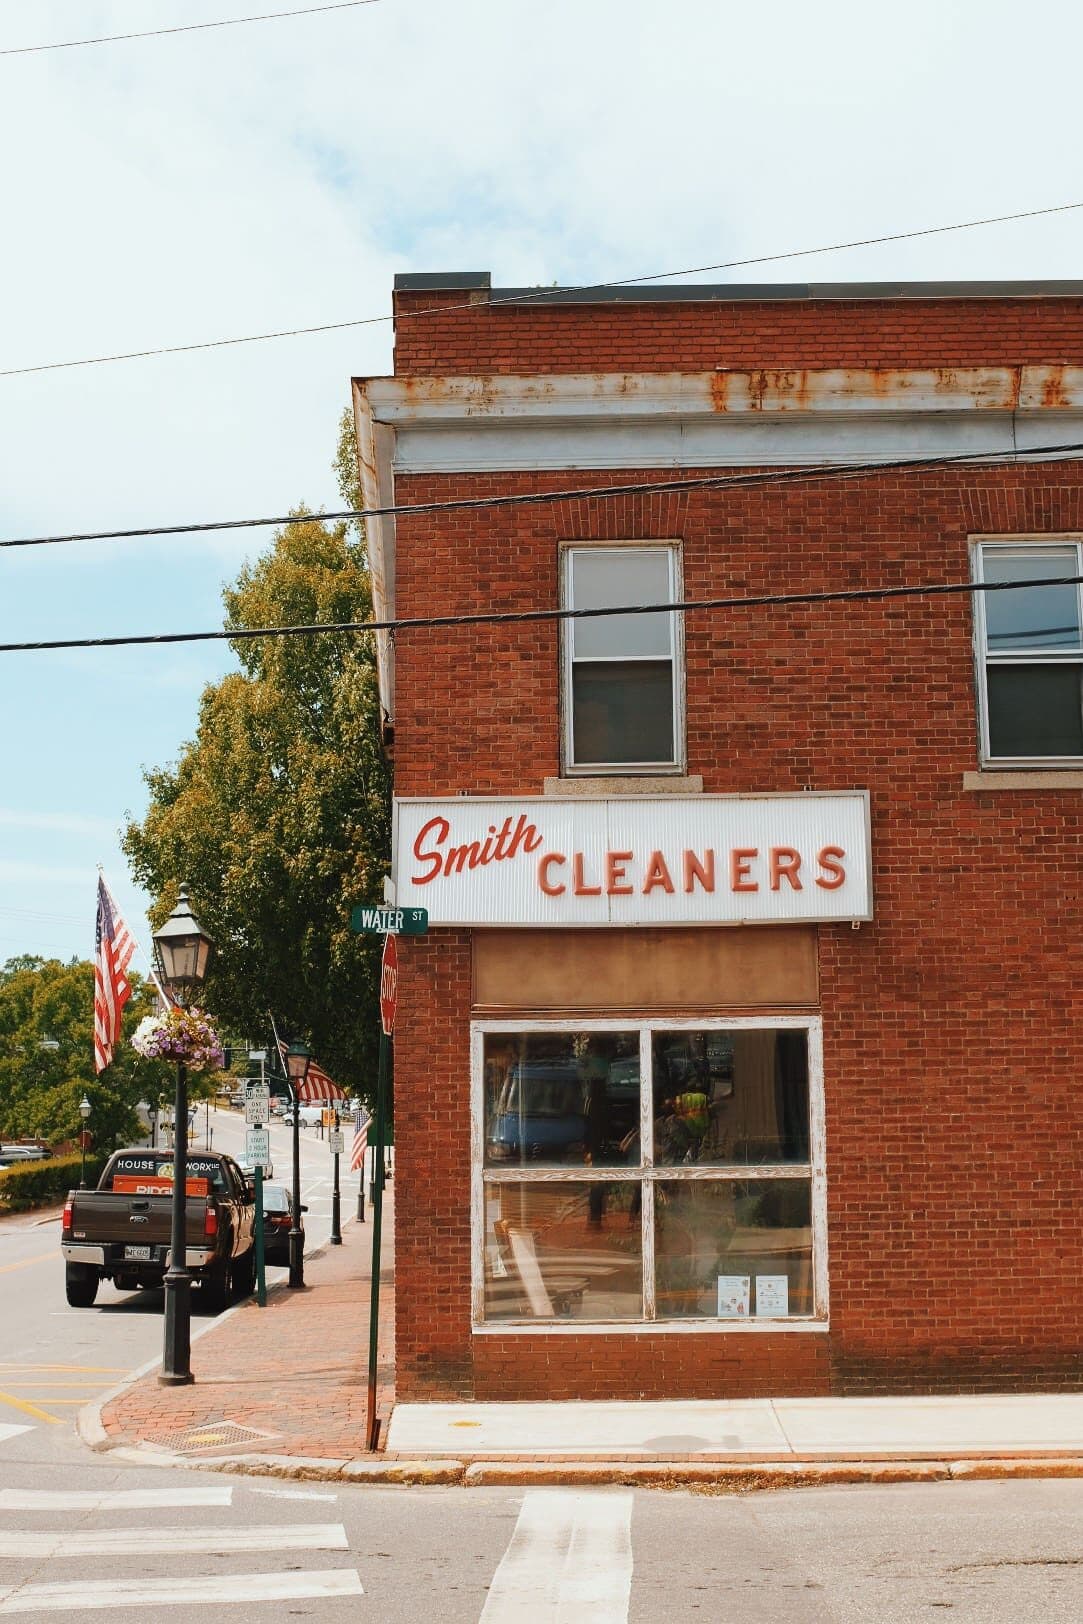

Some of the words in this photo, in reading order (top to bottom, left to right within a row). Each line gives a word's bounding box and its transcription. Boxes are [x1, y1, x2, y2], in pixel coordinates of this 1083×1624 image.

[411, 814, 543, 885] Smith
[537, 845, 847, 897] CLEANERS
[361, 909, 404, 929] WATER
[412, 911, 424, 921] ST
[383, 963, 397, 1002] STOP
[117, 1160, 155, 1170] HOUSE
